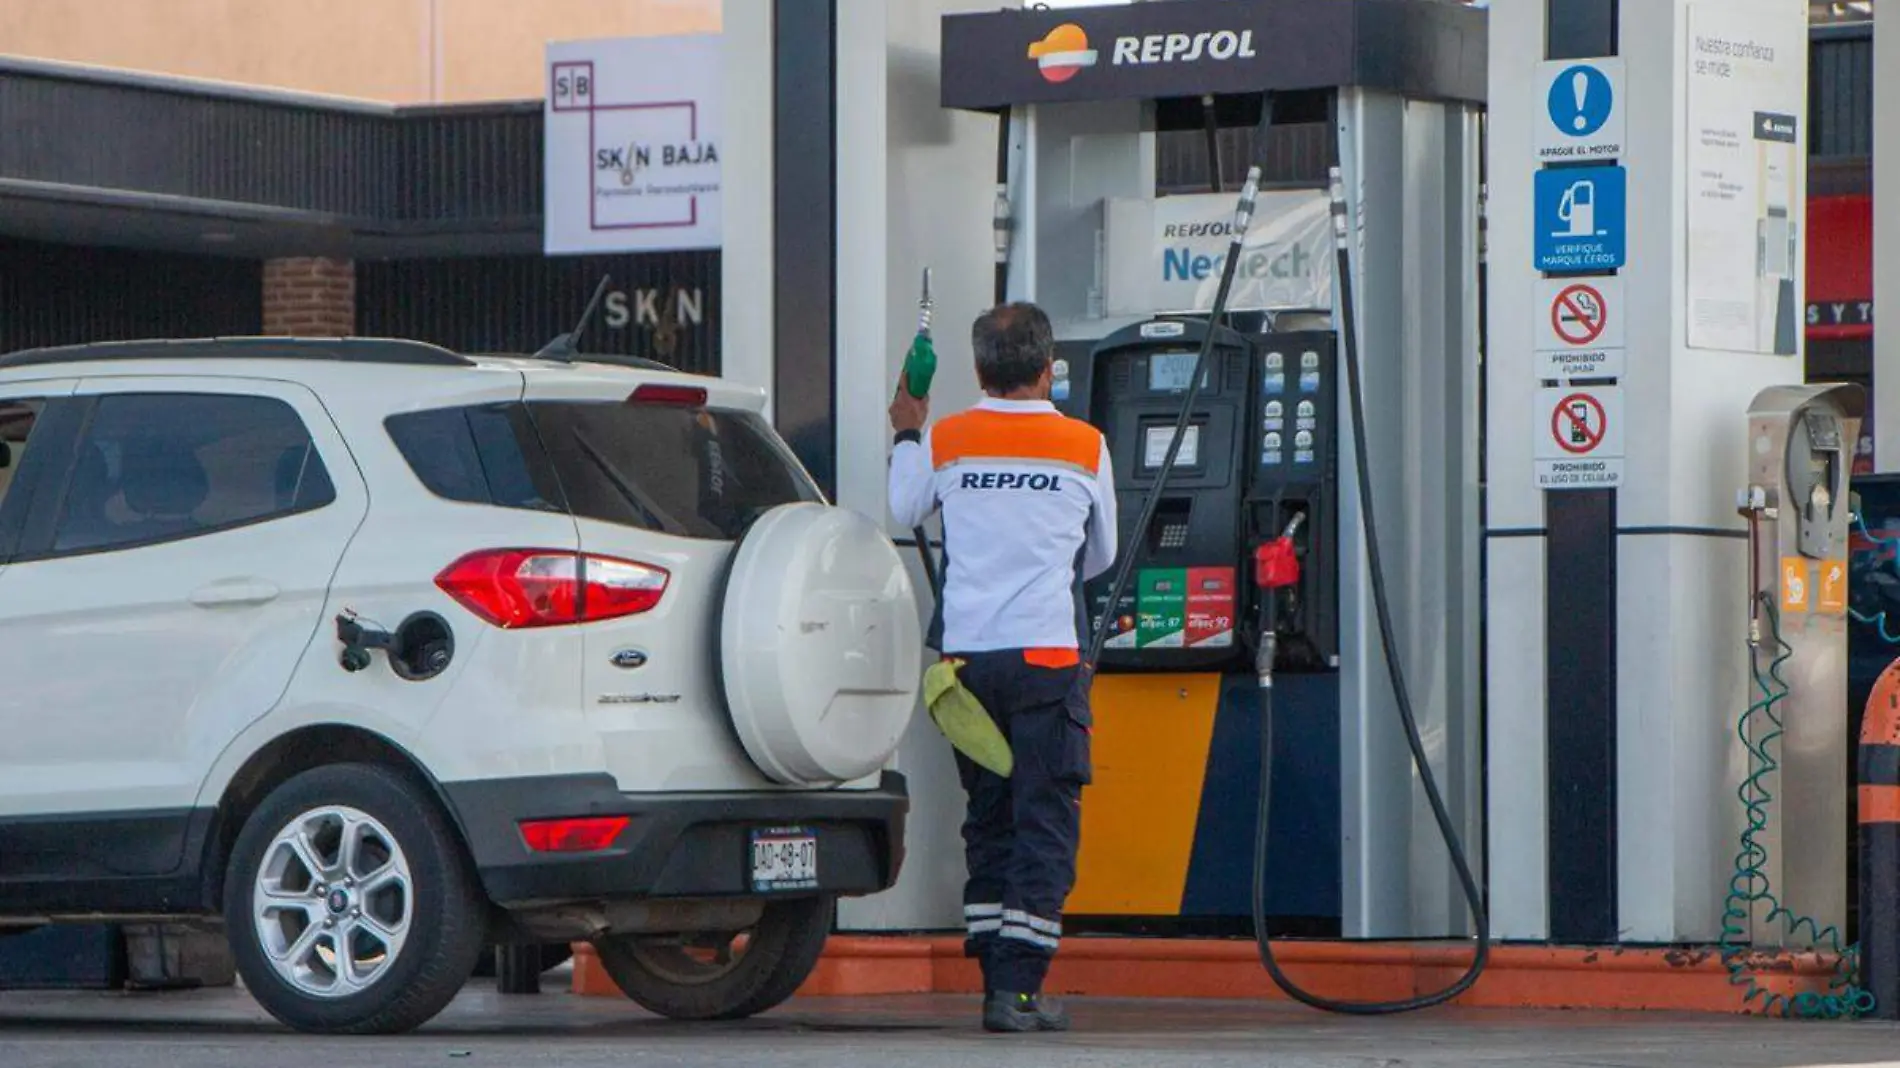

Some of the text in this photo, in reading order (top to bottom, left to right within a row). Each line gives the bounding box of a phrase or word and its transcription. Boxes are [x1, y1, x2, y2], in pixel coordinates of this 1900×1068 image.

[1112, 29, 1256, 65] REPSOL
[1589, 144, 1619, 154] MOTOR
[662, 144, 719, 167] BAJA
[1164, 221, 1232, 238] REPSOL
[1555, 244, 1603, 254] VERIFIQUE
[1542, 255, 1582, 265] MARQUE
[1831, 303, 1845, 323] Y
[1552, 353, 1605, 363] PROHIBIDO
[1563, 364, 1595, 374] FUMAR
[1552, 462, 1606, 471] PROHIBIDO
[961, 472, 1062, 491] REPSOL
